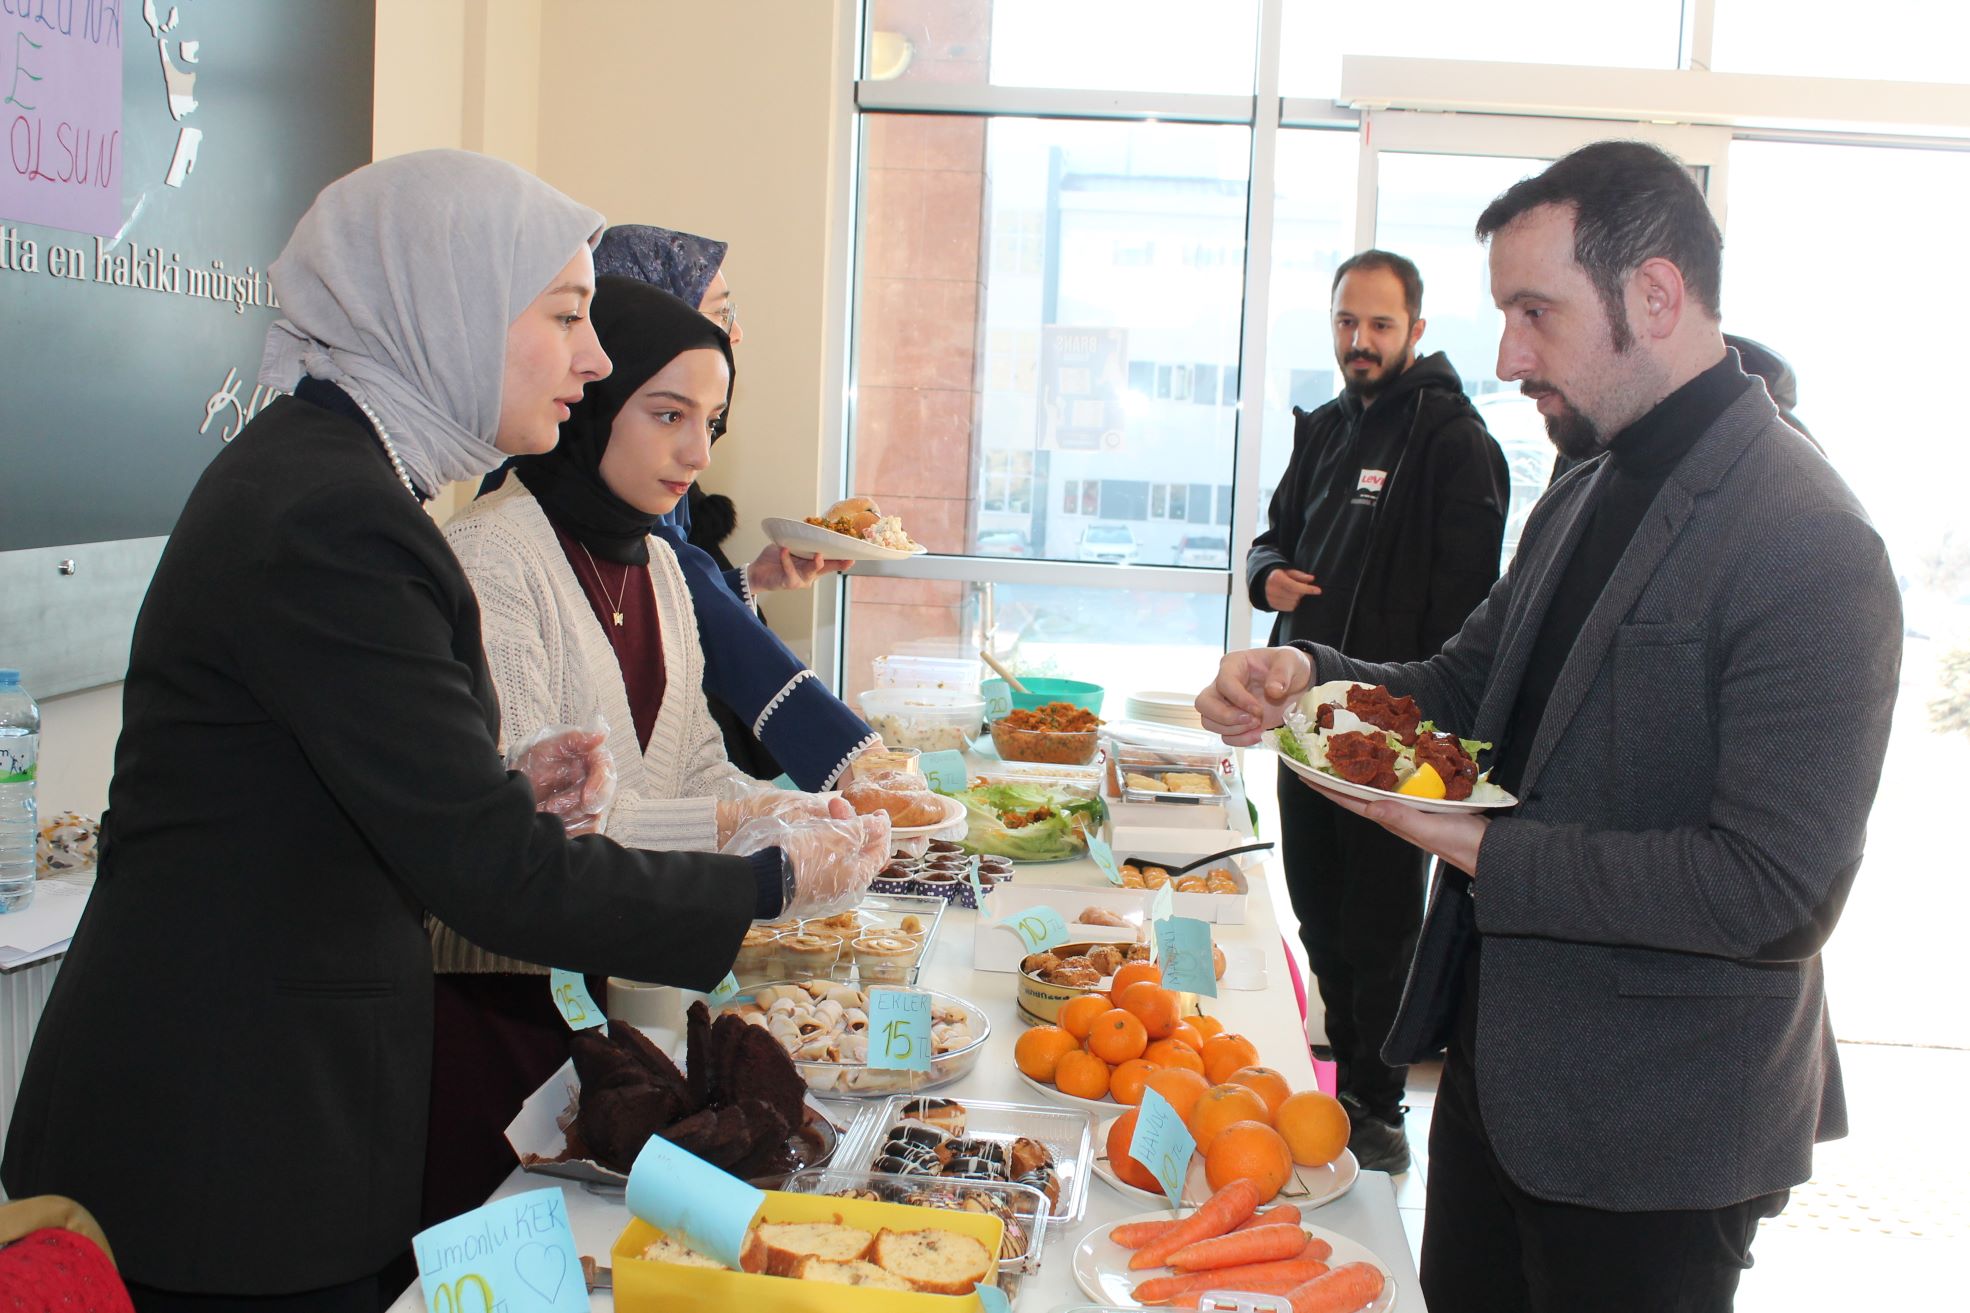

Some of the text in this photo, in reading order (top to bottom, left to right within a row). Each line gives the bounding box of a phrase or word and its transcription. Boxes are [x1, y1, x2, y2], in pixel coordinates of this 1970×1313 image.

[11, 116, 118, 188] OLSUN
[48, 245, 87, 280] en
[93, 236, 181, 294] hakiki
[186, 260, 261, 314] mürşit
[1019, 917, 1047, 946] 10
[878, 993, 928, 1013] EKLER
[881, 1020, 913, 1060] 15
[515, 1199, 566, 1240] KEK
